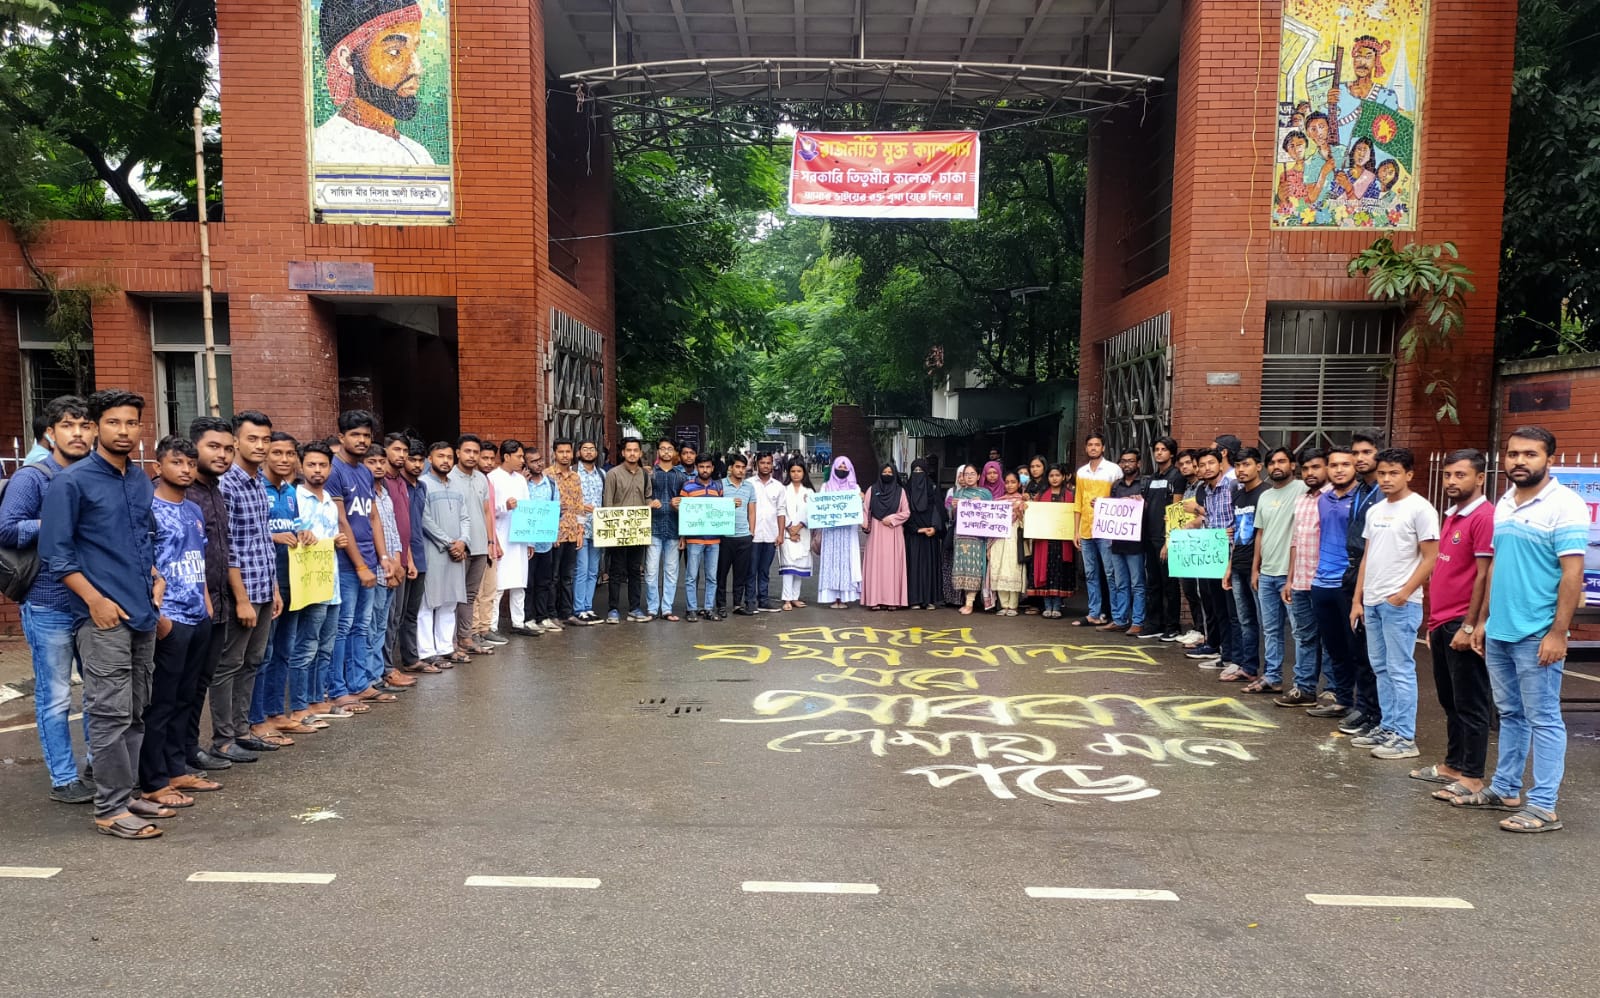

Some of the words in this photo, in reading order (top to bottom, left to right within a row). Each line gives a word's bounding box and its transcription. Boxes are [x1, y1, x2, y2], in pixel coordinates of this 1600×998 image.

[819, 136, 877, 158] রাজনীতি
[882, 141, 908, 165] মুক্ত
[801, 168, 844, 184] সরকারি
[847, 168, 890, 187] তিতুমীর
[893, 171, 935, 185] কলেজ,
[939, 171, 966, 184] ঢাকা
[356, 186, 368, 198] মীর
[370, 187, 389, 198] নিসার
[391, 187, 408, 199] আলী
[410, 187, 437, 200] তিতুমীর
[804, 191, 831, 202] আমার
[834, 191, 867, 202] ভাইয়ের
[869, 191, 885, 202] রক্ত
[905, 191, 927, 202] যেতে
[1100, 502, 1135, 518] FLOODY
[1095, 519, 1137, 536] AUGUST
[776, 626, 978, 648] বন্যায়
[927, 643, 1168, 676] মানুষ
[813, 667, 980, 691] মরে
[719, 690, 1280, 732] আবরার
[767, 729, 1057, 764] তোমায়
[1087, 732, 1260, 766] মনে
[901, 763, 1162, 803] পড়ে
